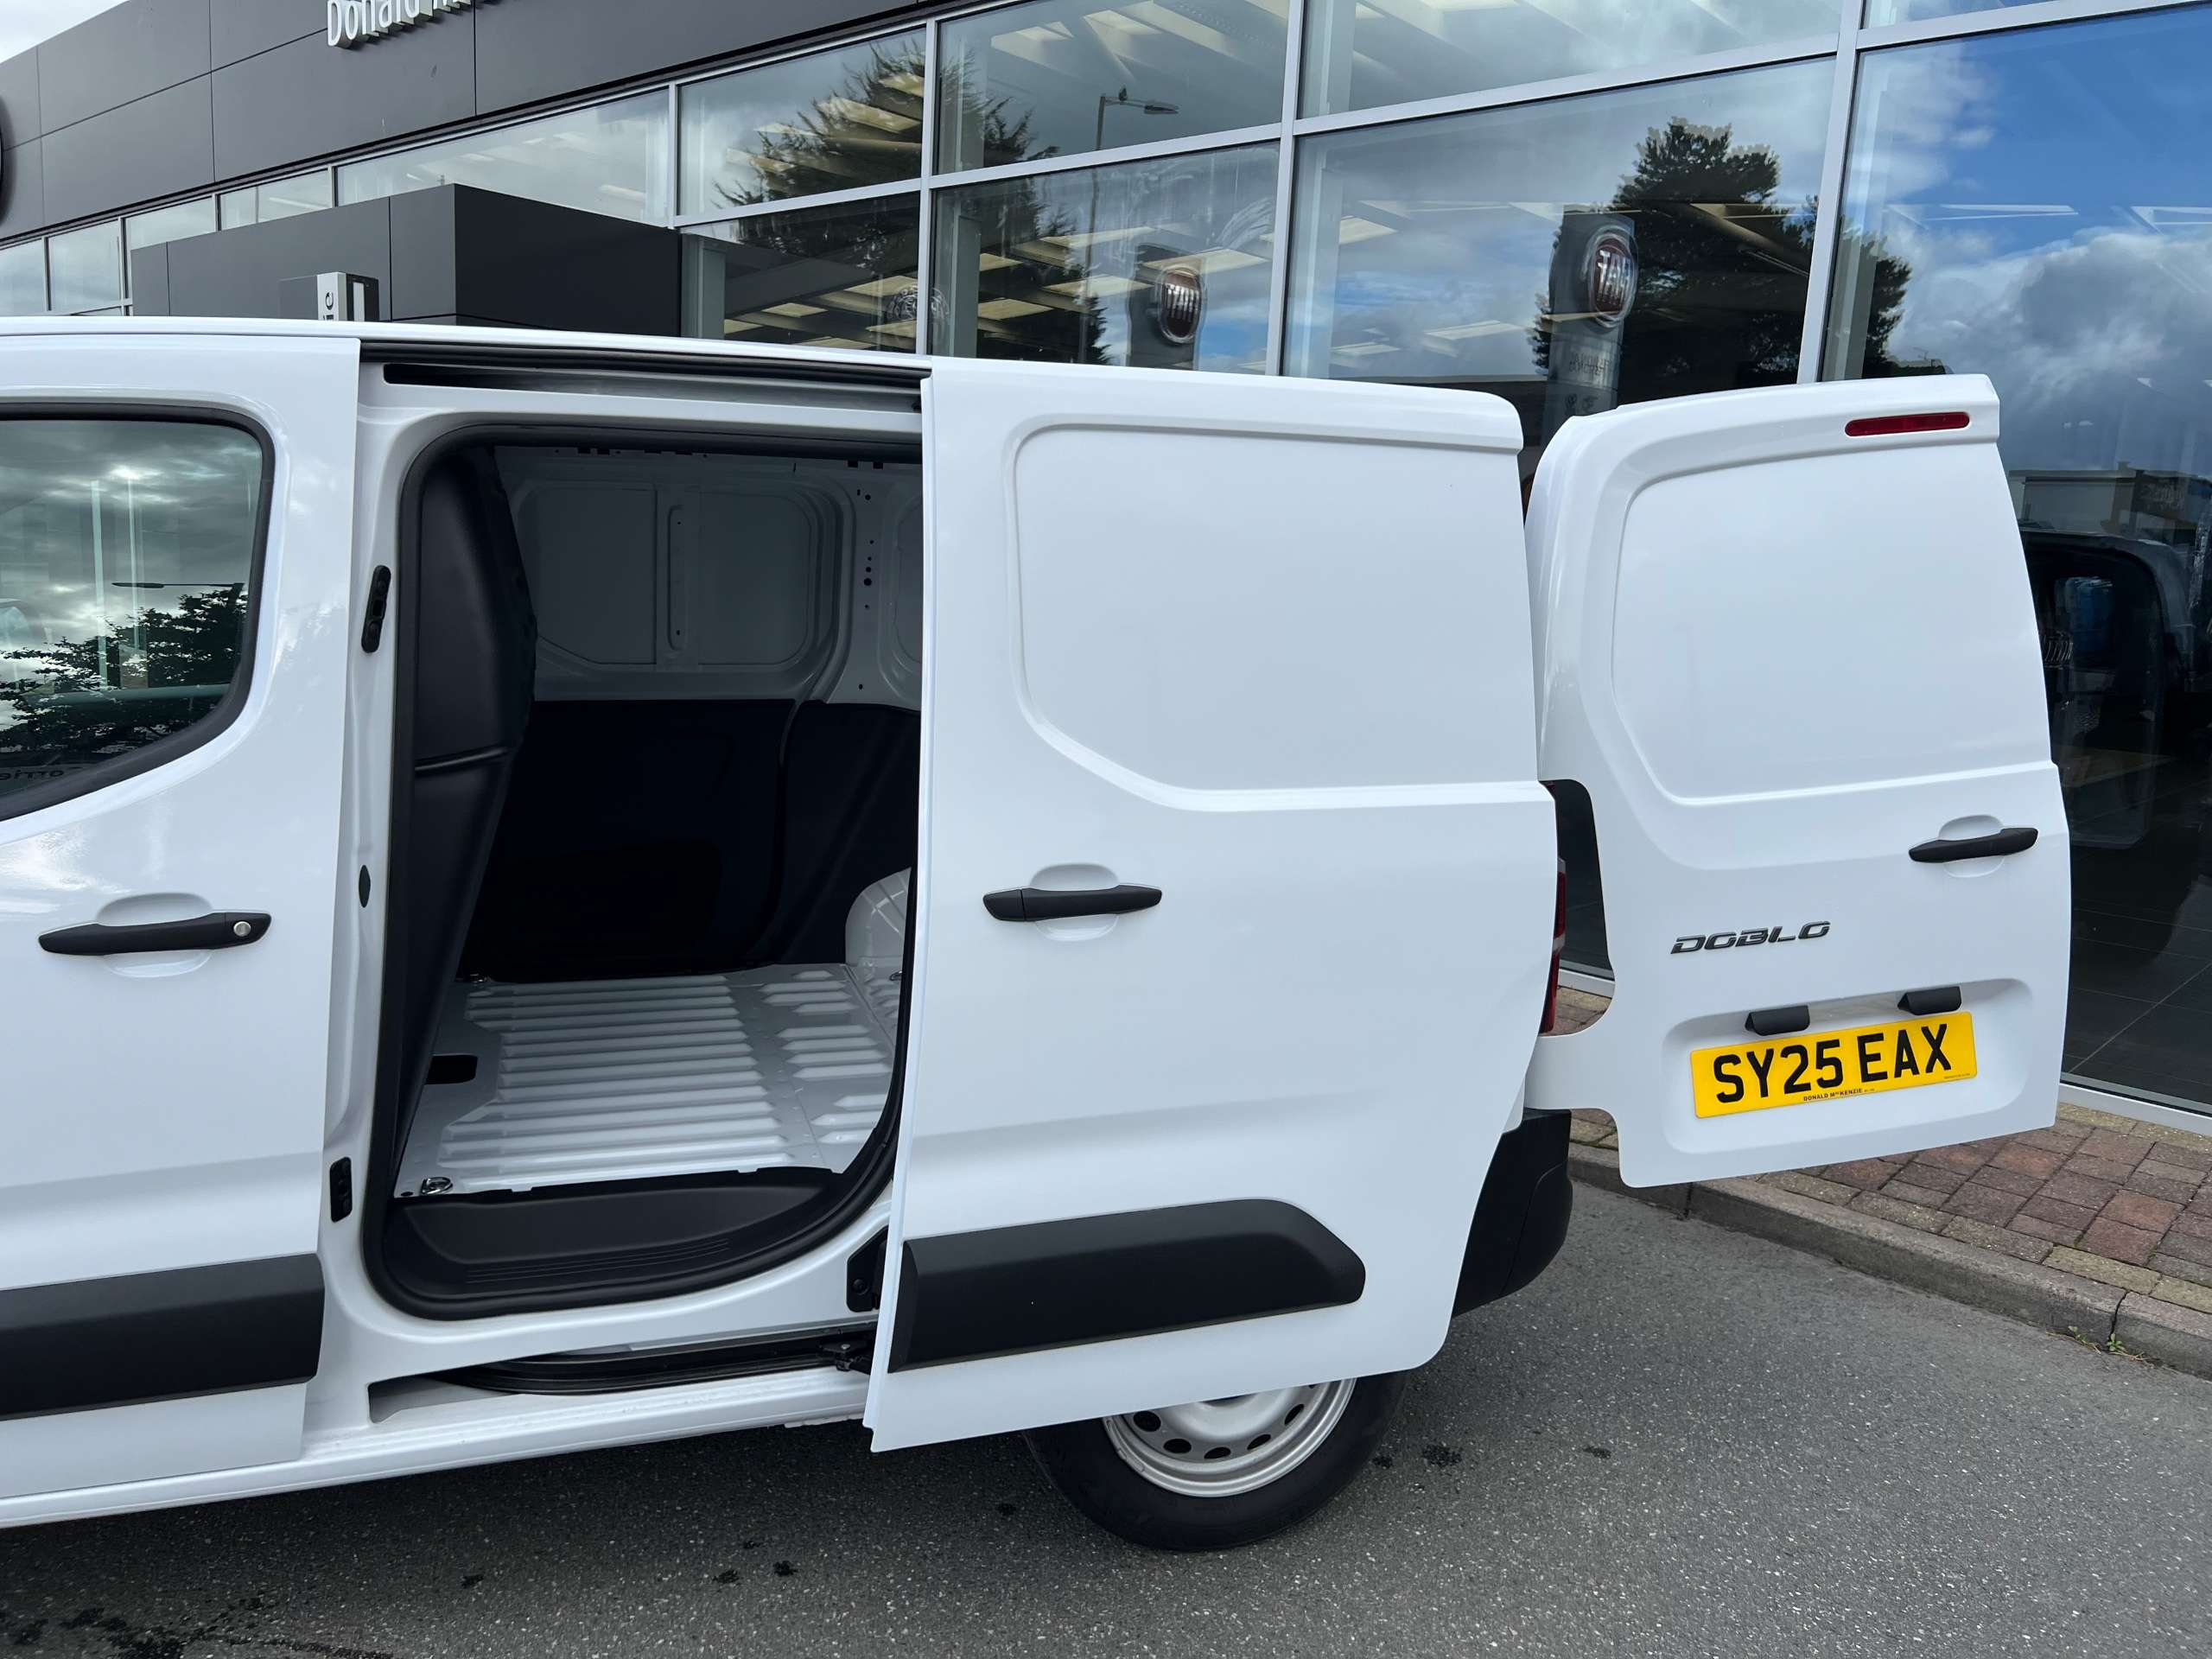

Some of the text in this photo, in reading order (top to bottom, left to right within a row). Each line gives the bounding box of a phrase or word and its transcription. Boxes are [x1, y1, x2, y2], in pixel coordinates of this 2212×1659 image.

[1669, 920, 1831, 955] DOBLO
[1713, 1023, 1952, 1103] SY25 EAX
[1803, 1092, 1829, 1102] DONALD
